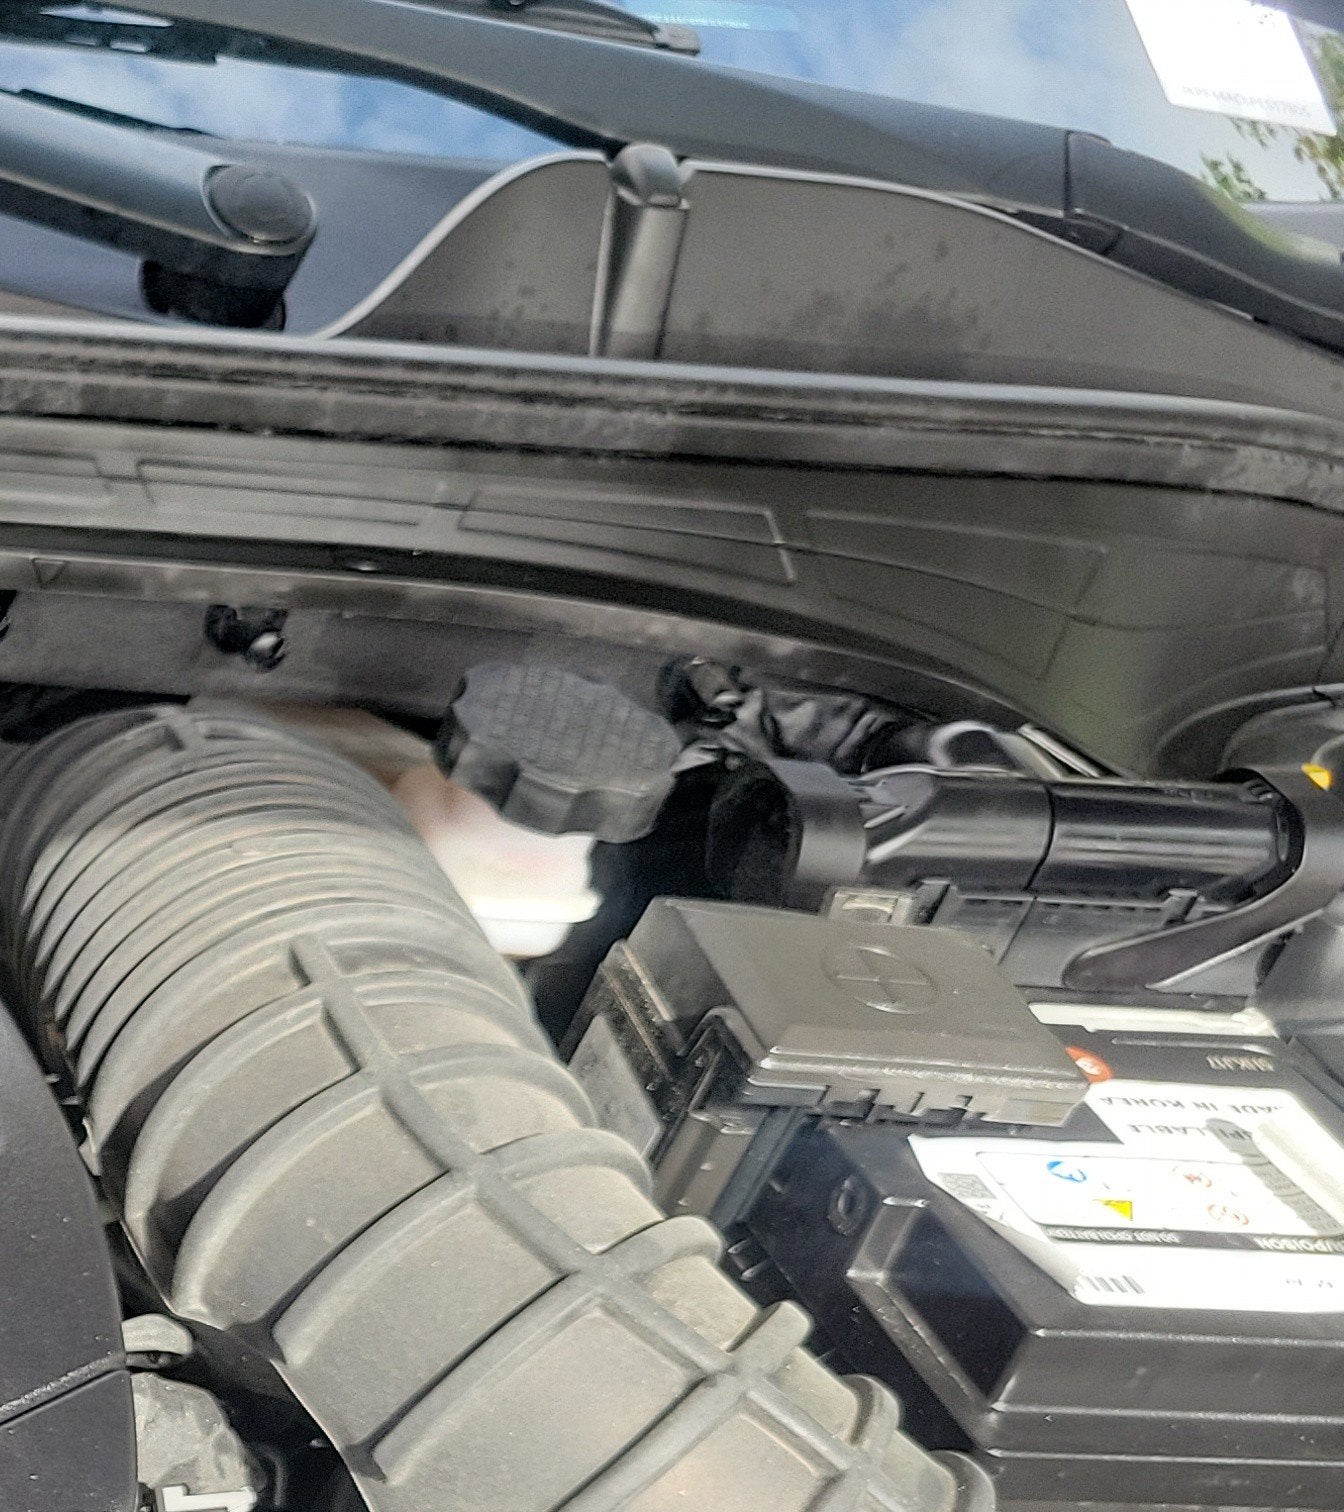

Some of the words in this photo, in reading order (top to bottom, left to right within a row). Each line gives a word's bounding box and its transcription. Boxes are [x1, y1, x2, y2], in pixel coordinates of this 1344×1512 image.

[1100, 1096, 1184, 1109] KOREA
[1192, 1101, 1223, 1112] IN
[1231, 1103, 1283, 1115] ADE
